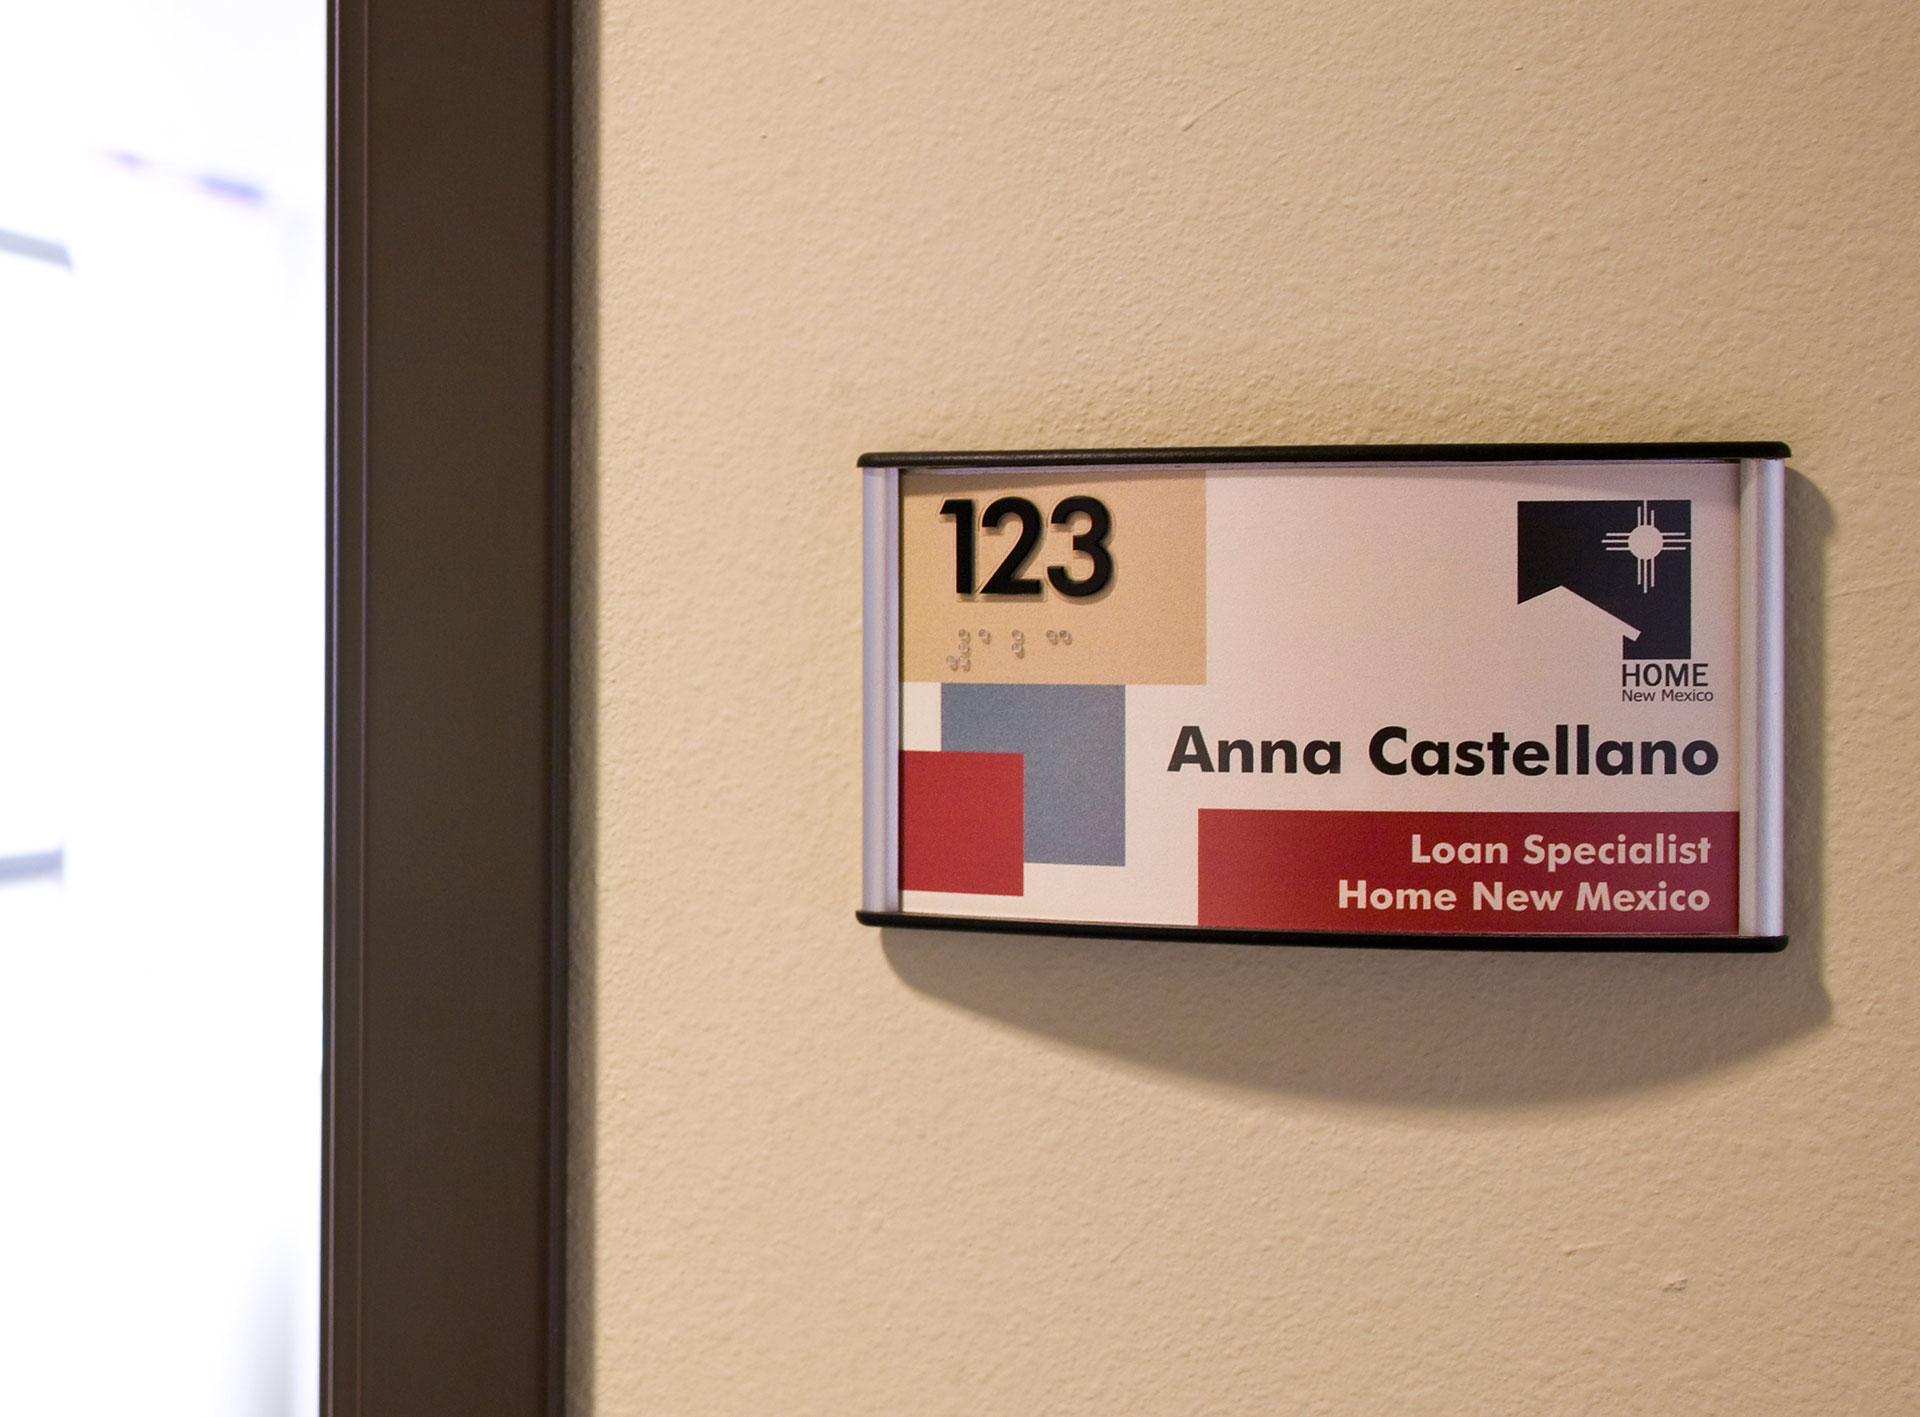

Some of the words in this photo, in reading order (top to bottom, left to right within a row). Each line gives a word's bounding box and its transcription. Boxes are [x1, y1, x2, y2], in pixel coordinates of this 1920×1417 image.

[939, 495, 1116, 598] 123
[1622, 663, 1709, 687] HOME
[1622, 688, 1657, 702] New
[1661, 688, 1714, 702] Mexico
[1167, 725, 1342, 775] Anna
[1368, 724, 1719, 776] Castellano
[1411, 834, 1508, 864] Loan
[1523, 834, 1711, 872] Specialist
[1338, 879, 1457, 910] Home
[1473, 881, 1564, 911] New
[1575, 880, 1711, 912] Mexico
